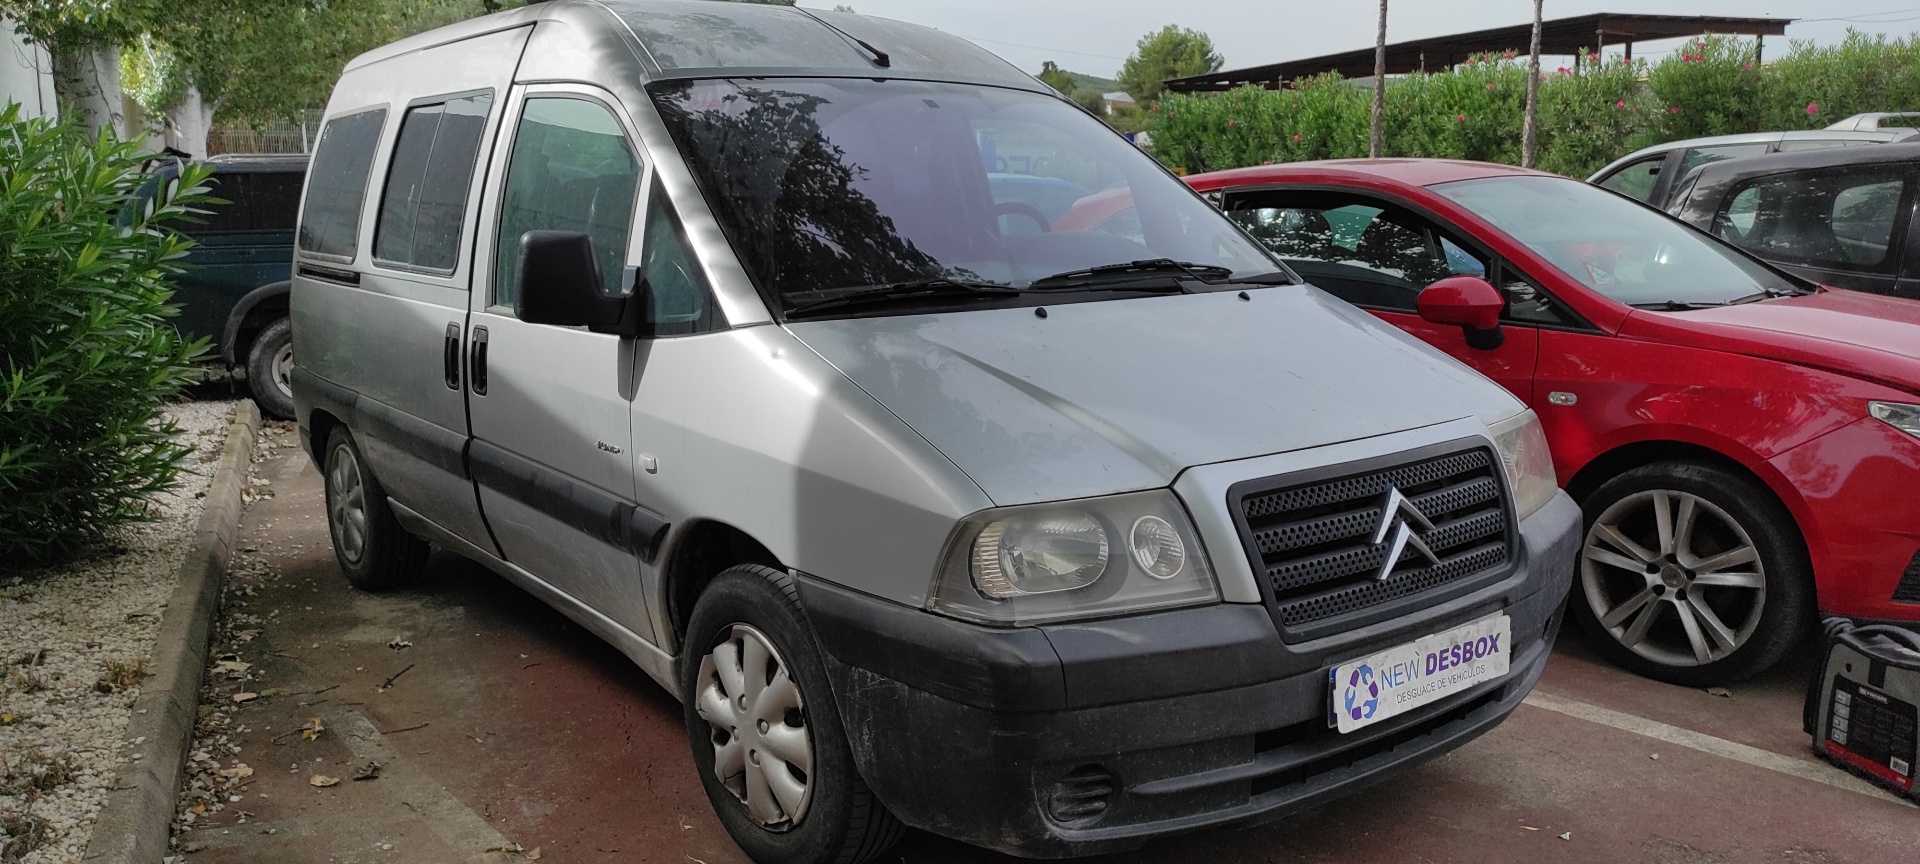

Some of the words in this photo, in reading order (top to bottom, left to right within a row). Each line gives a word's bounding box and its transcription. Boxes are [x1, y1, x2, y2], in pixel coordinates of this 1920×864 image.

[1380, 658, 1420, 691] NEW
[1425, 632, 1502, 677] DESBOX
[1396, 682, 1436, 704] DESGUACE
[1437, 679, 1446, 689] DE
[1447, 664, 1486, 686] VEHICULOS
